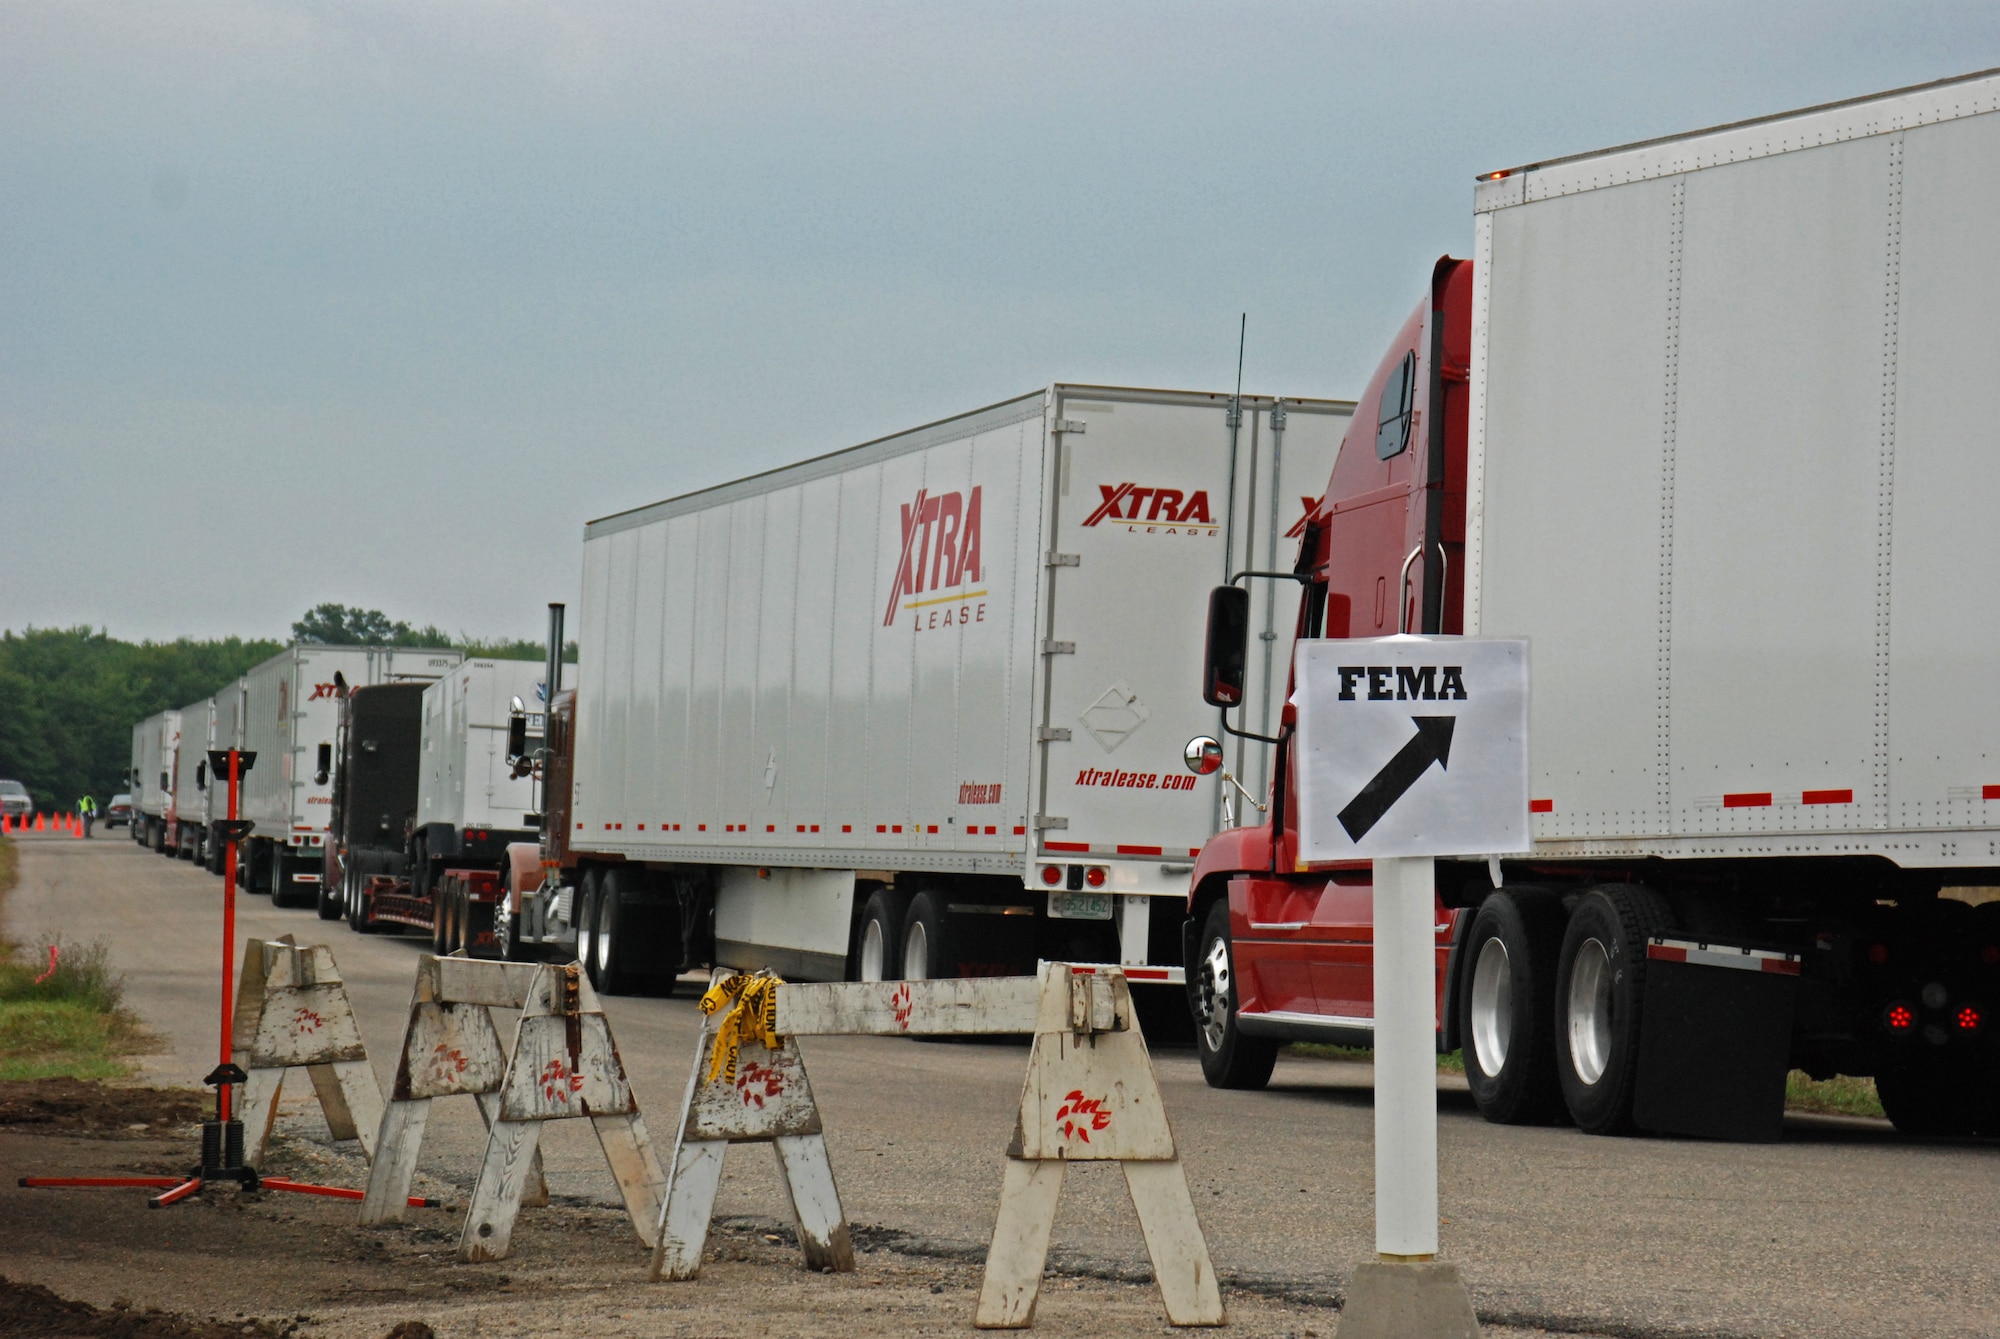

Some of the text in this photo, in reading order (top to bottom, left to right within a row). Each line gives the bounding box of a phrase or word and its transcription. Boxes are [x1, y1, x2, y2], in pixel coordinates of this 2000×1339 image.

[1080, 482, 1210, 527] XTRA
[1128, 525, 1218, 537] LEASE
[883, 484, 982, 627] XTRA
[914, 603, 986, 632] LEASE
[1337, 666, 1468, 701] FEMA
[958, 781, 1002, 805] xtralease.com
[1075, 767, 1197, 791] xtralease.com
